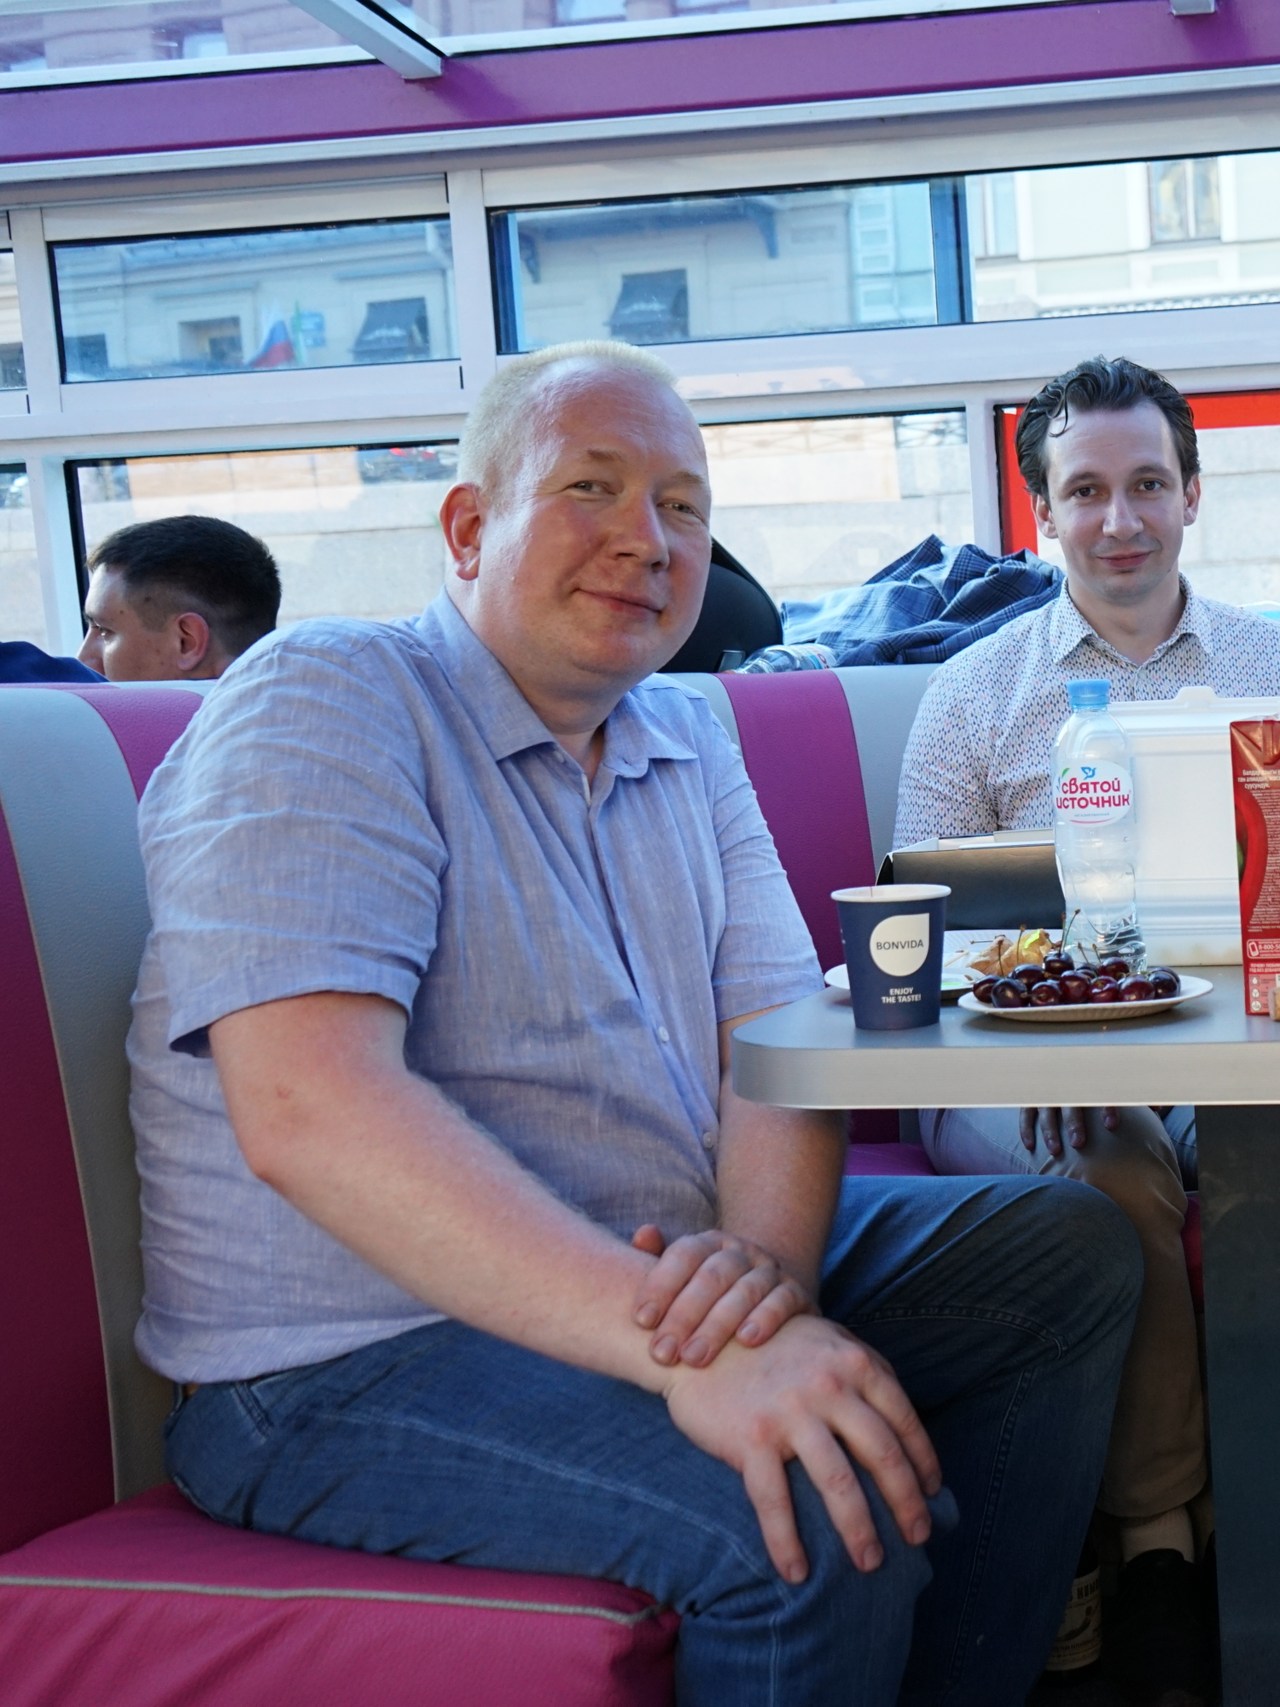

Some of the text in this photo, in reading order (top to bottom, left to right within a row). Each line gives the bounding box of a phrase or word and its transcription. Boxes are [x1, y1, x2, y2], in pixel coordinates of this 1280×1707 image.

[1061, 777, 1121, 794] СВЯТОЙ
[1056, 794, 1130, 809] ИСТОЧНИК
[876, 939, 924, 951] BONVIDA
[889, 987, 914, 996] ENJOY
[881, 994, 922, 1004] THE TASTE!
